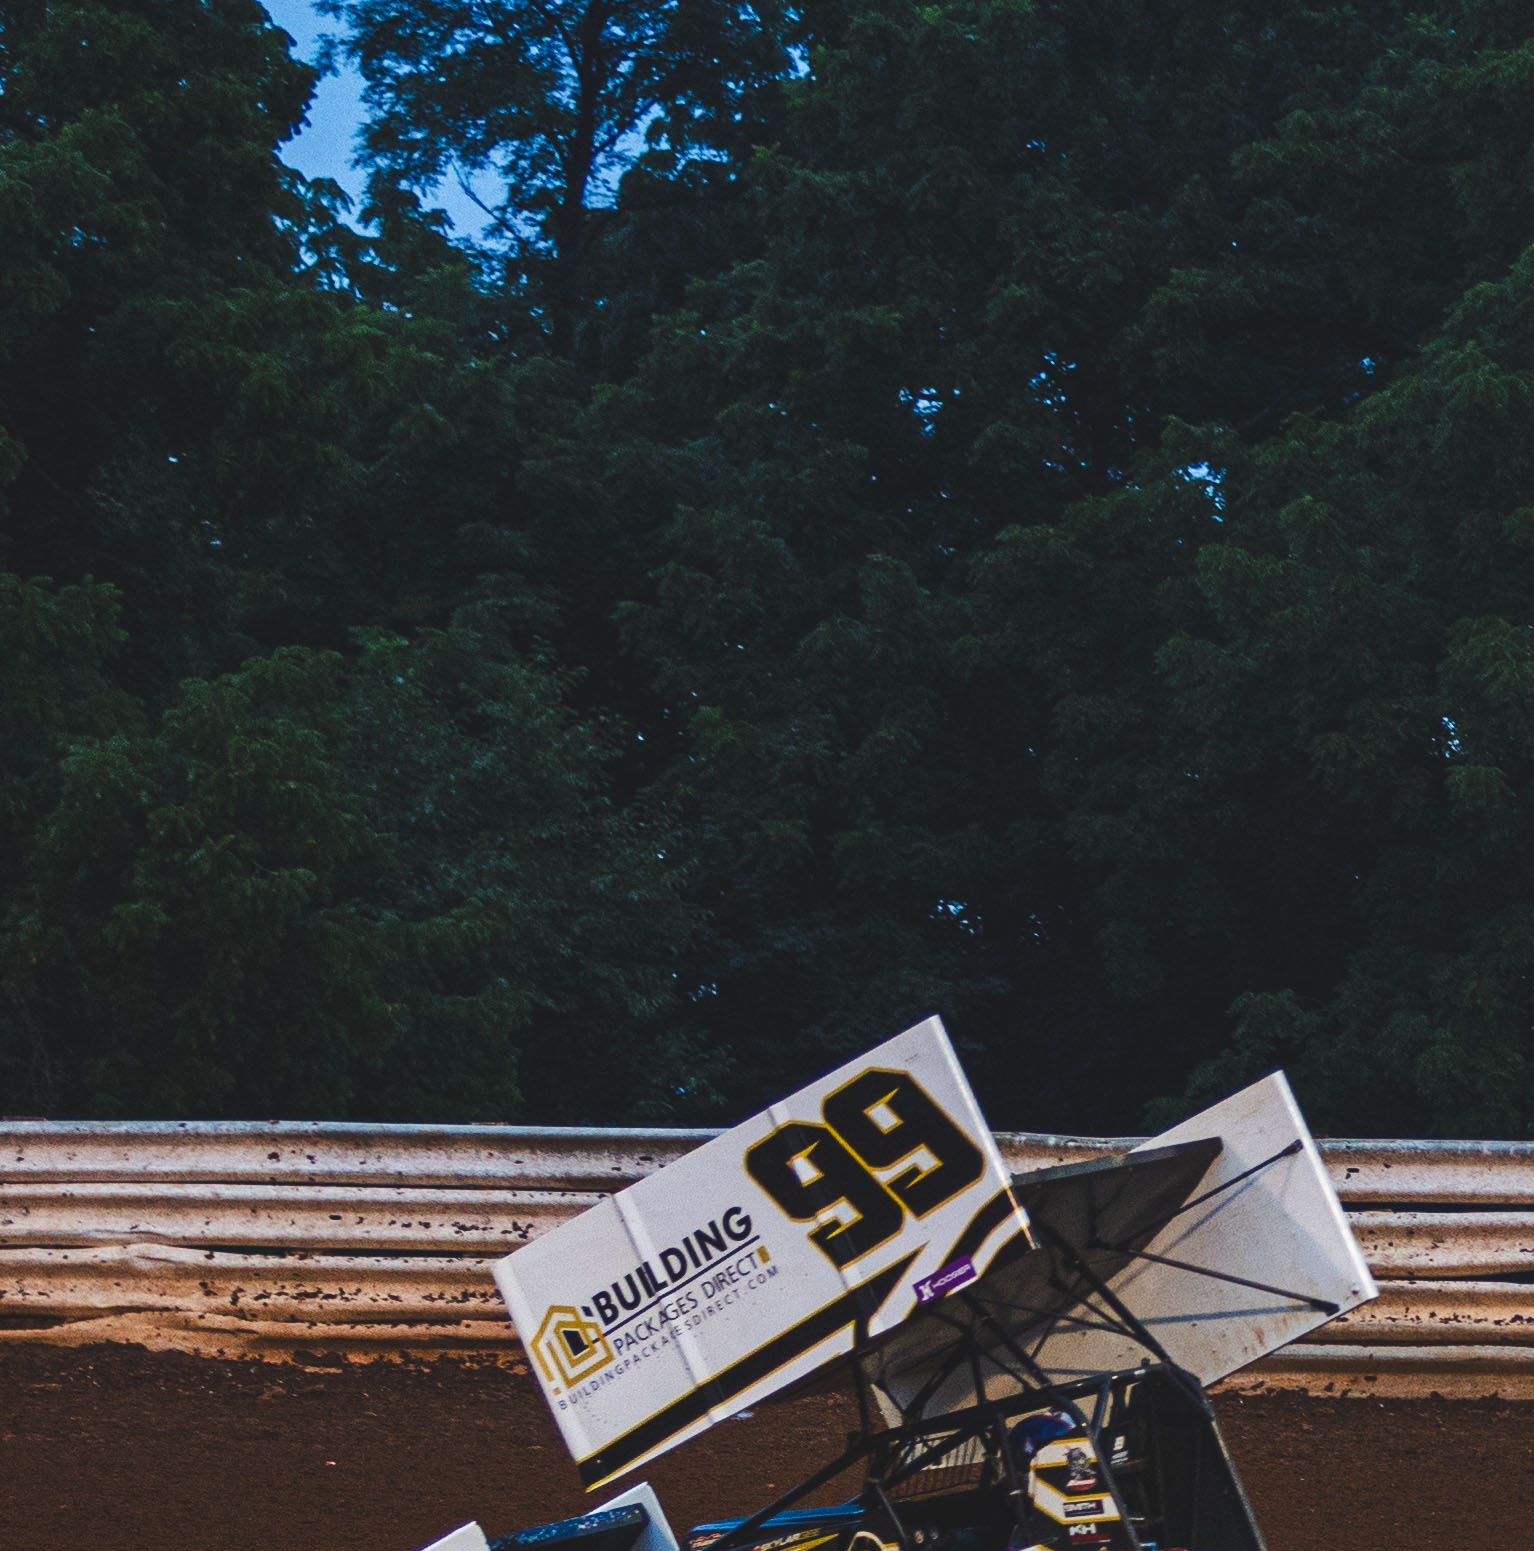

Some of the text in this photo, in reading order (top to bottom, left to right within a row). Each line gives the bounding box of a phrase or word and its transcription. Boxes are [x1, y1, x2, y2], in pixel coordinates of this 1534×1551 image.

[745, 1067, 986, 1271] 99
[592, 1206, 753, 1326] BUILDING
[612, 1251, 759, 1356] PACKAGES DIRECT
